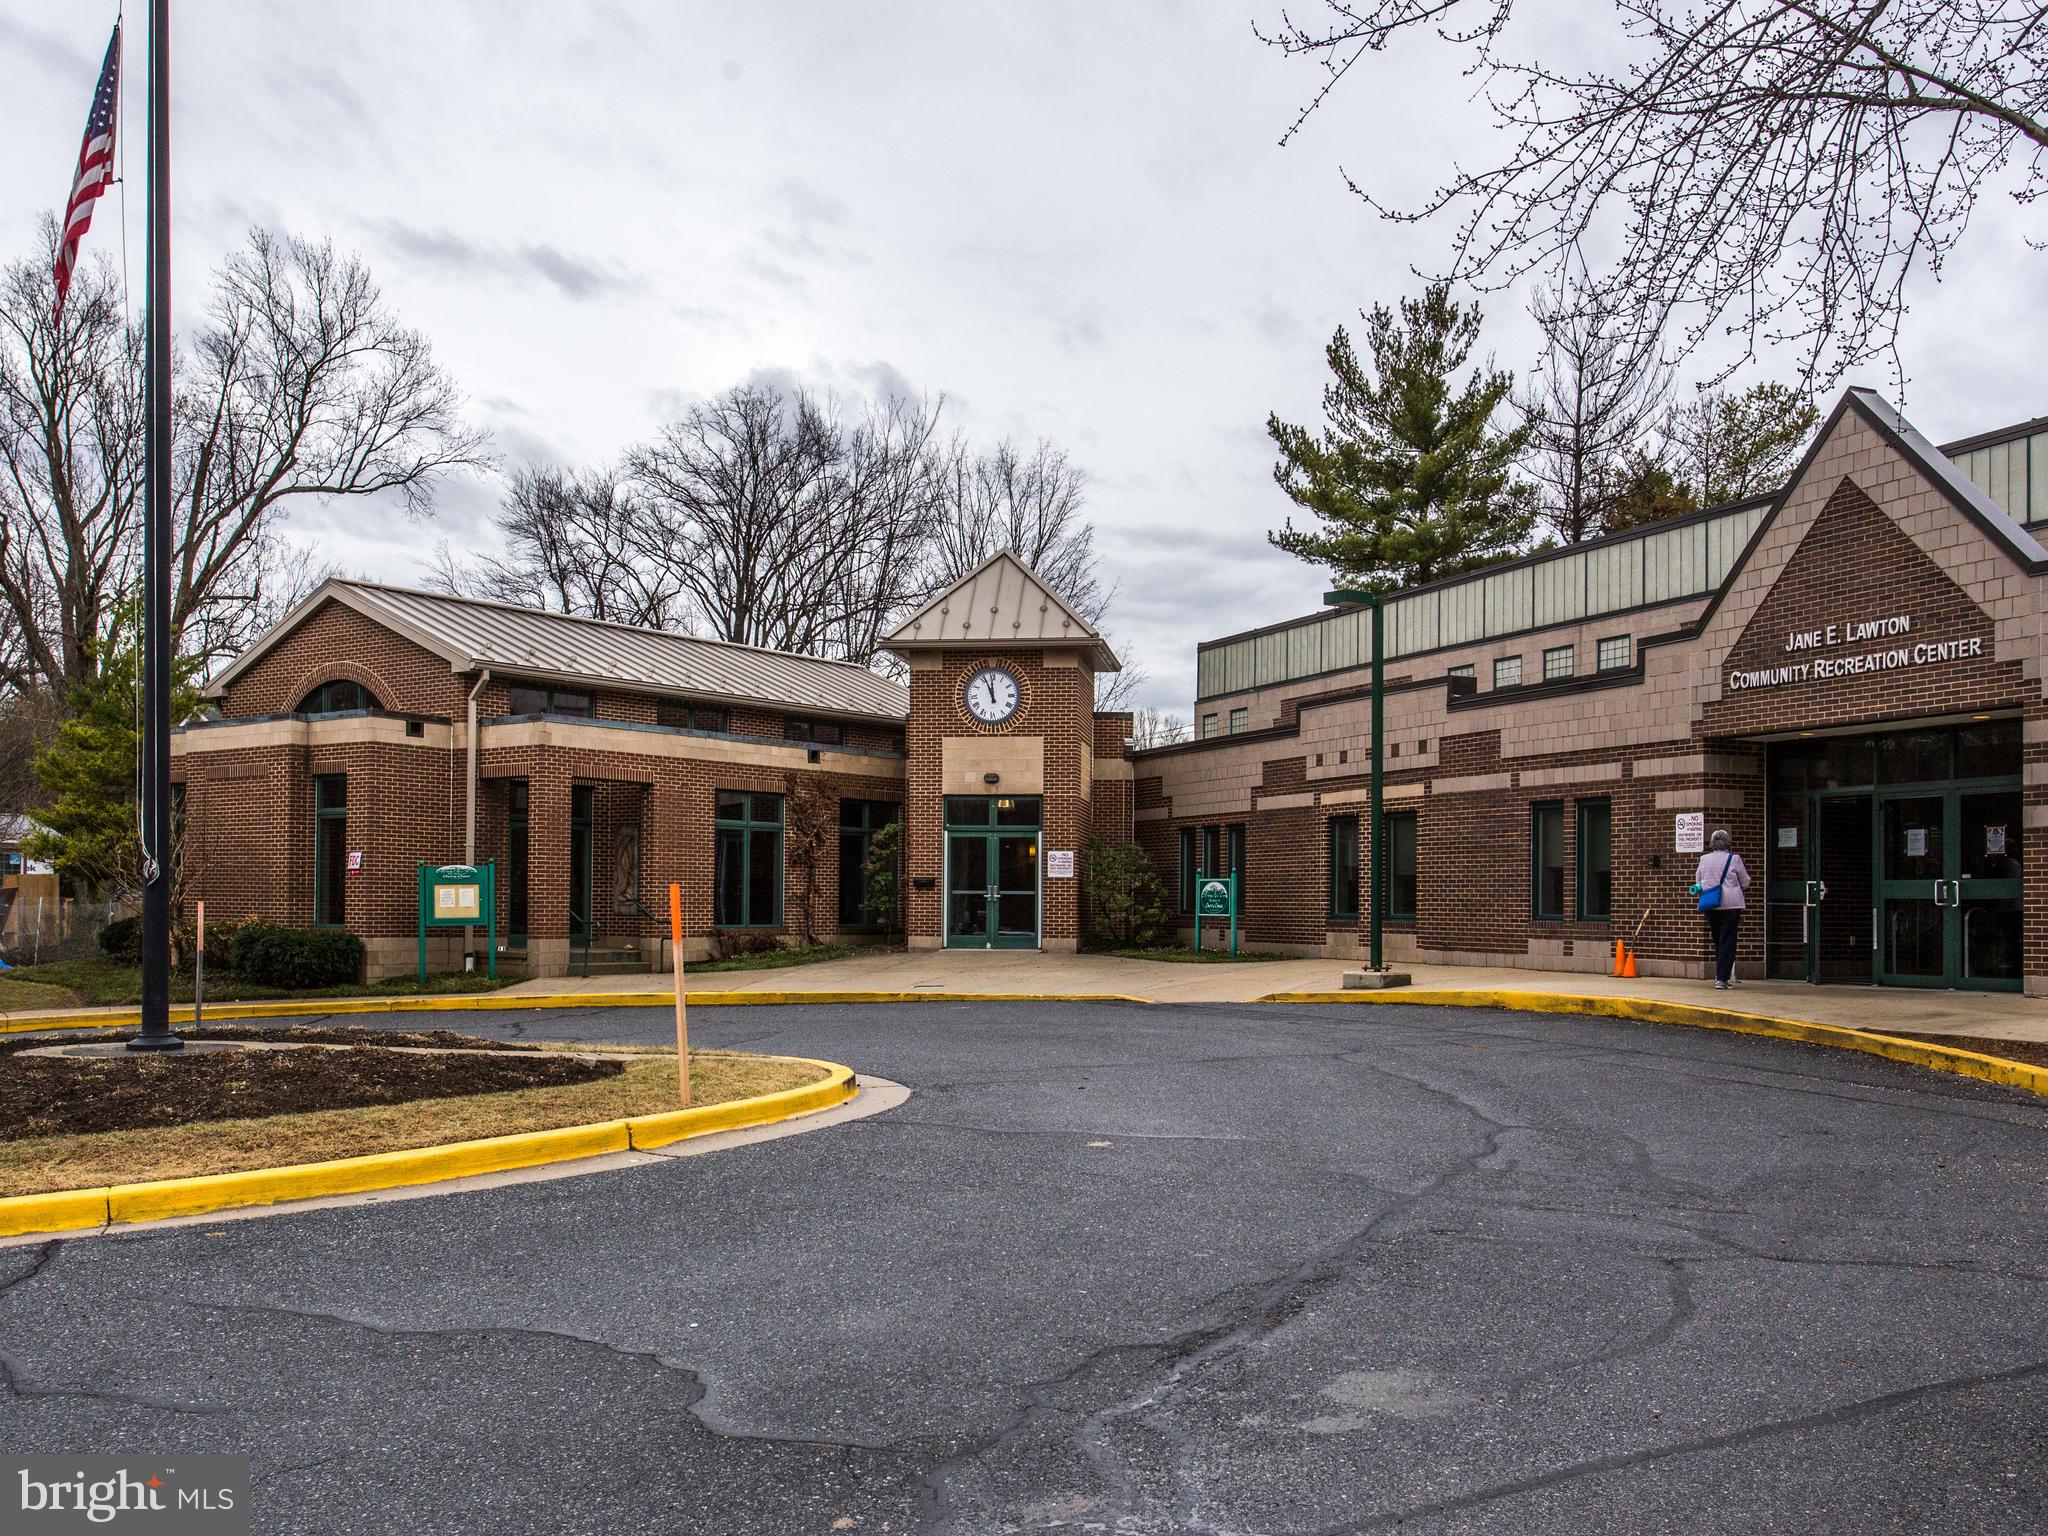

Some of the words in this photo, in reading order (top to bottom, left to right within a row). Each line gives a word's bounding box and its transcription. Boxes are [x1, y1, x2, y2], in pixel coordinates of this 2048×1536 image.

[1785, 630, 1822, 652] JANE
[1826, 625, 1841, 645] E.
[1847, 615, 1910, 641] LAWTON
[1730, 663, 1809, 690] COMMUNITY
[1814, 648, 1908, 679] RECREATION
[1914, 637, 1982, 664] CENTER
